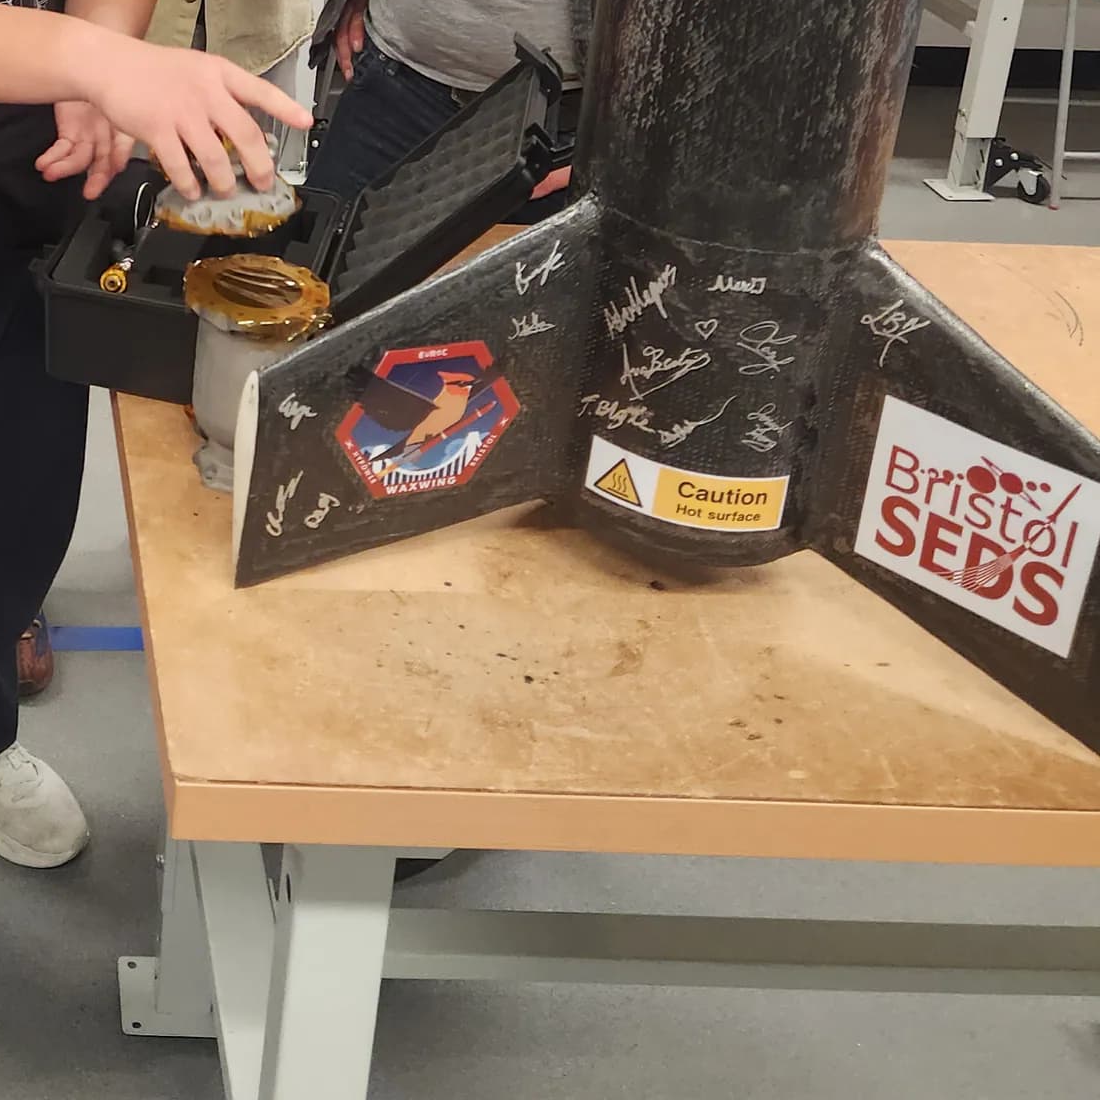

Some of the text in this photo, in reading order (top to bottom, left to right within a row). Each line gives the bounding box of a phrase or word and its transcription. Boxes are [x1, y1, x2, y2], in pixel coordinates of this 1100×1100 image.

[469, 433, 498, 468] BRISTOL
[384, 476, 458, 496] WAXWING
[677, 481, 768, 506] Caution
[675, 503, 762, 523] Hot surface
[885, 444, 1079, 569] Bristol
[874, 495, 1066, 627] SEDS
